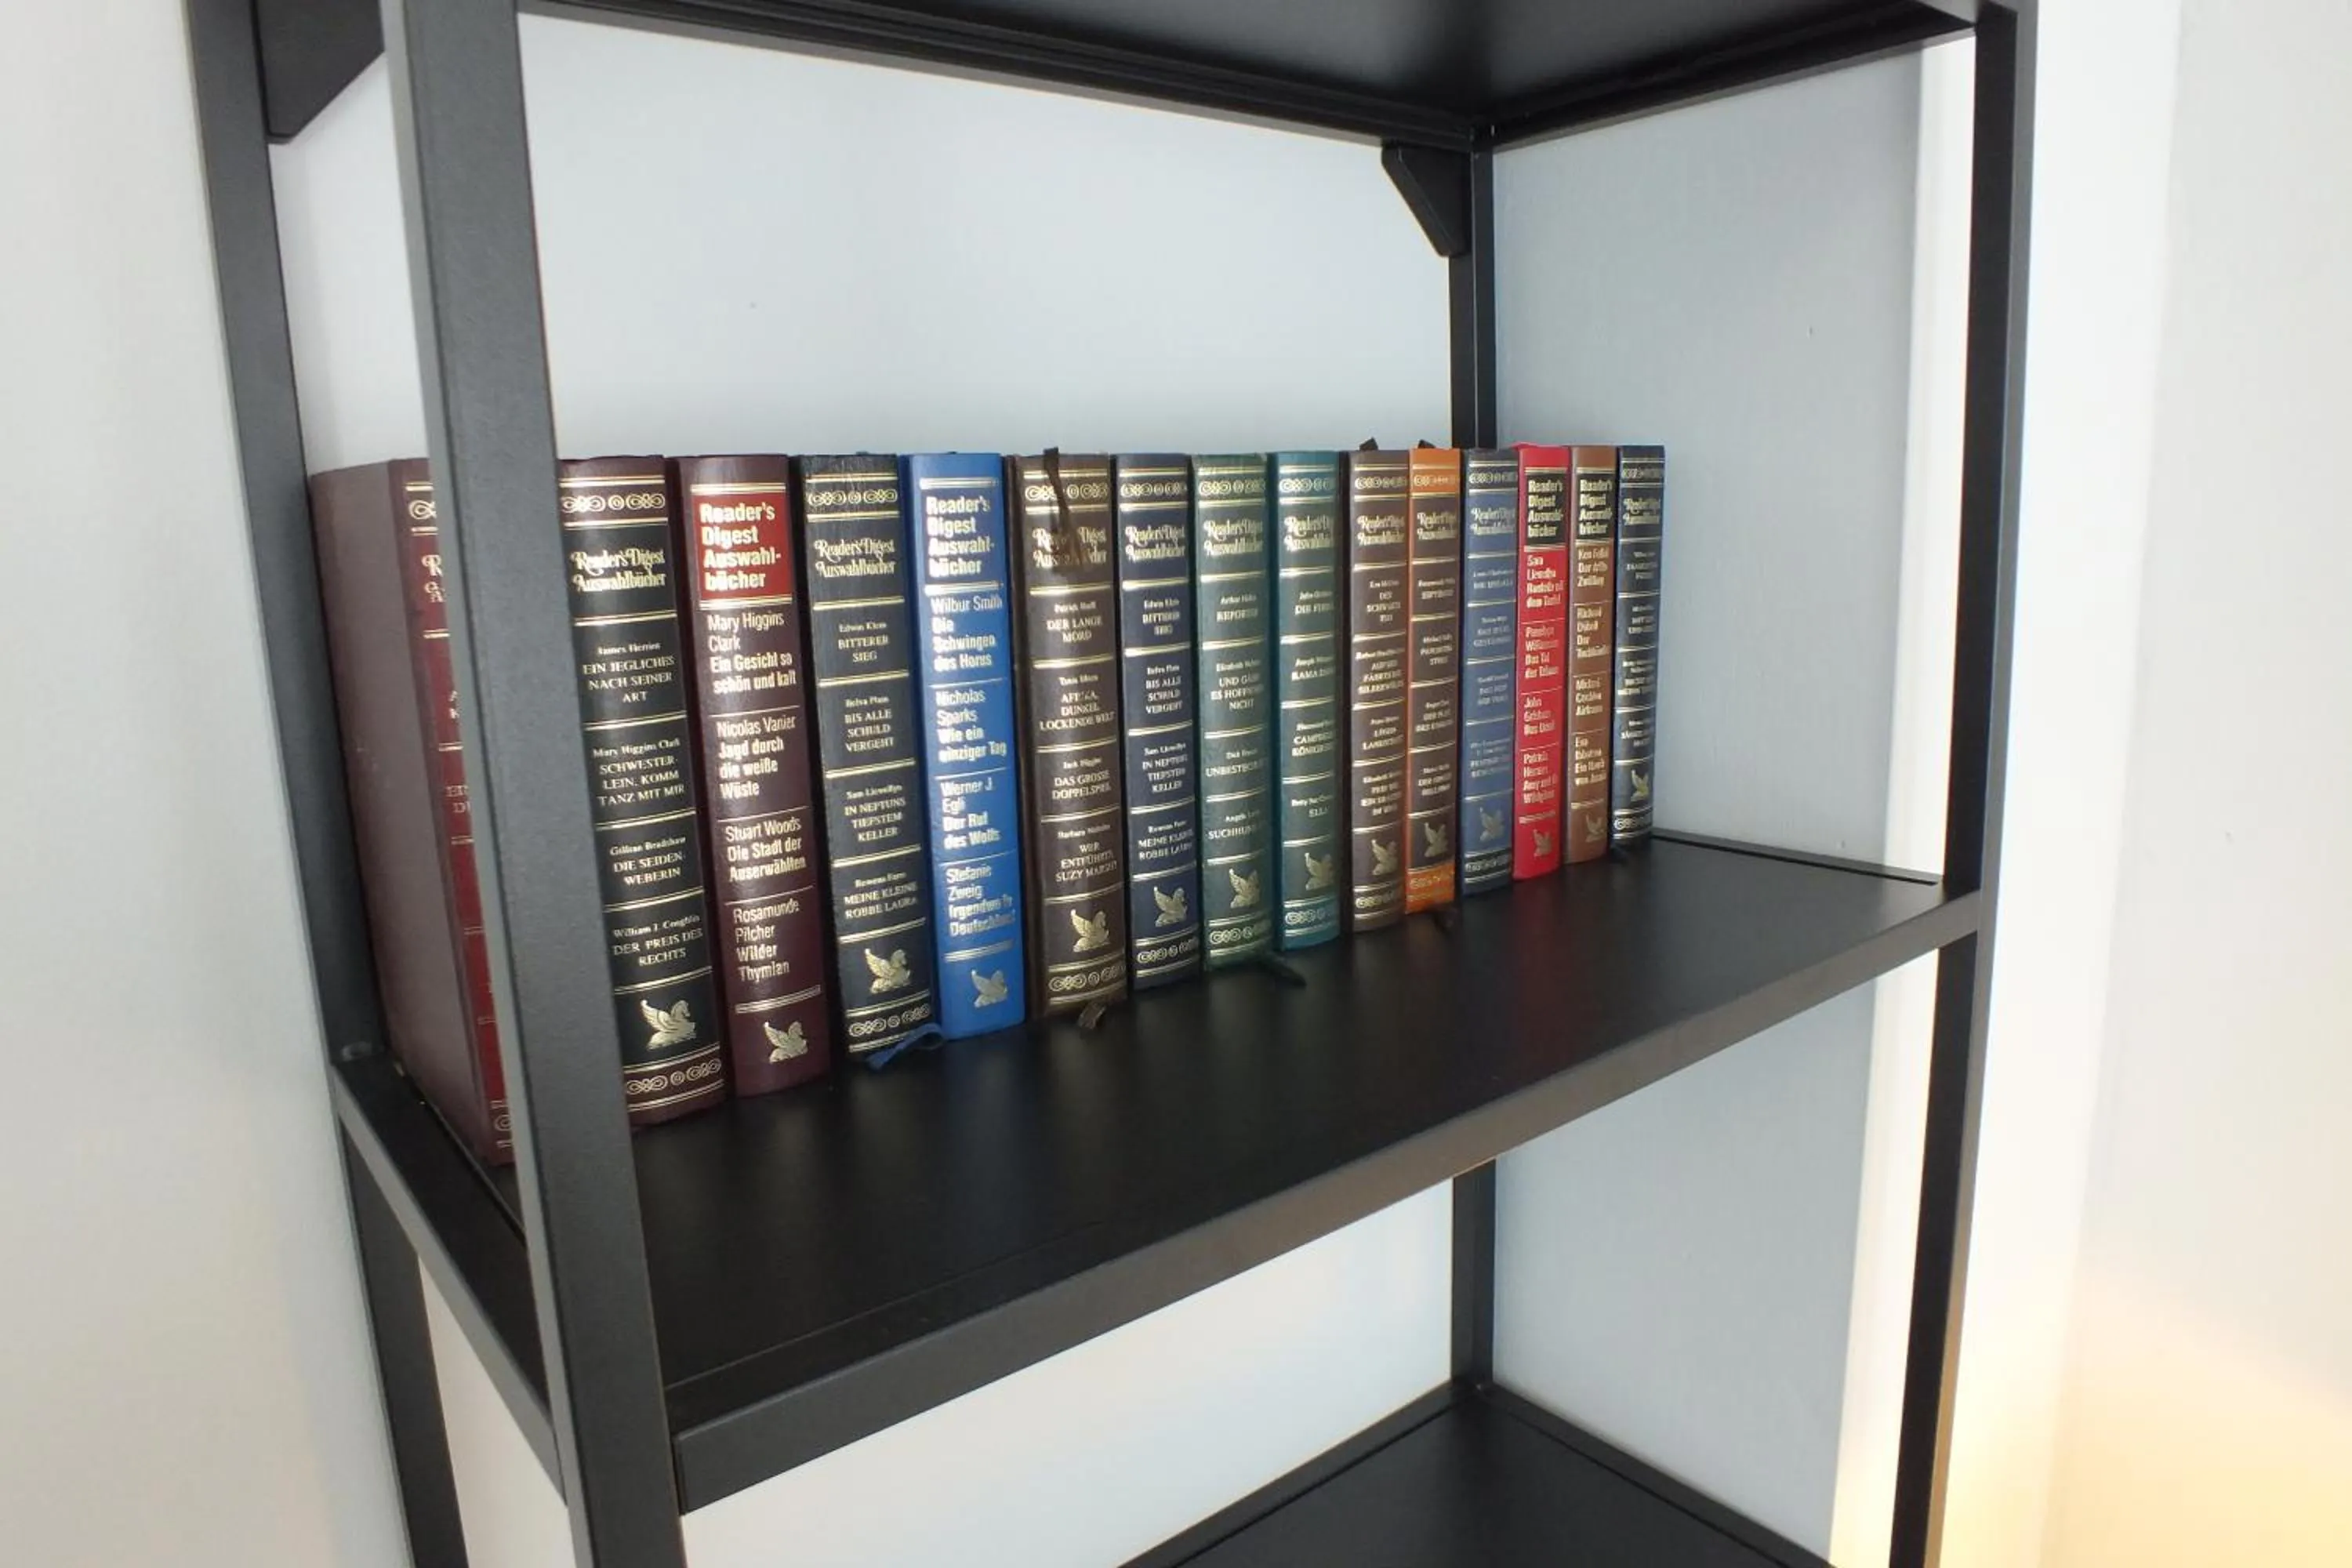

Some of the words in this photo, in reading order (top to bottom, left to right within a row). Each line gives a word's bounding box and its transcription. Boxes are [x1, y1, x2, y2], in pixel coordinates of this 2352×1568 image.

[699, 502, 775, 523] Reader's
[926, 495, 990, 515] Reader's
[702, 525, 759, 549] Digest
[927, 517, 976, 539] Digest
[571, 550, 626, 576] Reader's
[704, 546, 782, 568] Auswahl-
[706, 571, 766, 591] bücher
[931, 596, 970, 615] Wilbur
[973, 593, 1003, 611] Smith
[707, 614, 739, 633] Mary
[742, 611, 785, 631] Higgins
[1047, 618, 1069, 632] DER
[709, 635, 741, 652] Clark
[710, 657, 731, 673] Ein
[734, 652, 778, 672] Gesicht
[779, 652, 793, 666] so
[852, 651, 878, 663] SIEG
[583, 662, 606, 675] EIN
[589, 677, 627, 690] NACH
[630, 672, 672, 687] SEINER
[713, 674, 752, 694] schön
[753, 672, 775, 690] und
[777, 670, 797, 687] kalt
[622, 691, 648, 703] ART
[717, 720, 761, 738] Nicolas
[762, 714, 797, 733] Vanier
[844, 714, 862, 724] BIS
[865, 709, 893, 721] ALLE
[848, 724, 891, 739] SCHULD
[719, 739, 750, 760] Jagd
[752, 735, 785, 755] durch
[641, 770, 680, 785] KOMM
[720, 761, 741, 779] die
[742, 757, 779, 776] weiße
[720, 780, 760, 799] Wüste
[1054, 775, 1075, 787] DAS
[597, 793, 635, 806] TANZ
[637, 788, 661, 801] MIT
[664, 785, 684, 797] MIR
[844, 804, 858, 816] IN
[859, 797, 906, 814] NEPTUNS
[725, 822, 762, 842] Stuart
[763, 816, 801, 836] Woods
[858, 826, 898, 843] KELLER
[727, 844, 750, 862] Die
[751, 839, 783, 859] Stadt
[785, 837, 802, 853] der
[613, 860, 637, 873] DIE
[624, 867, 681, 885] WEBERIN
[844, 890, 880, 905] MEINE
[733, 898, 800, 924] Rosamunde
[613, 942, 641, 956] DER
[645, 935, 680, 949] PREIS
[682, 928, 703, 941] DES
[735, 924, 775, 943] Pilcher
[638, 947, 687, 967] RECHTS
[736, 943, 778, 962] Wilder
[738, 960, 789, 983] Thymian
